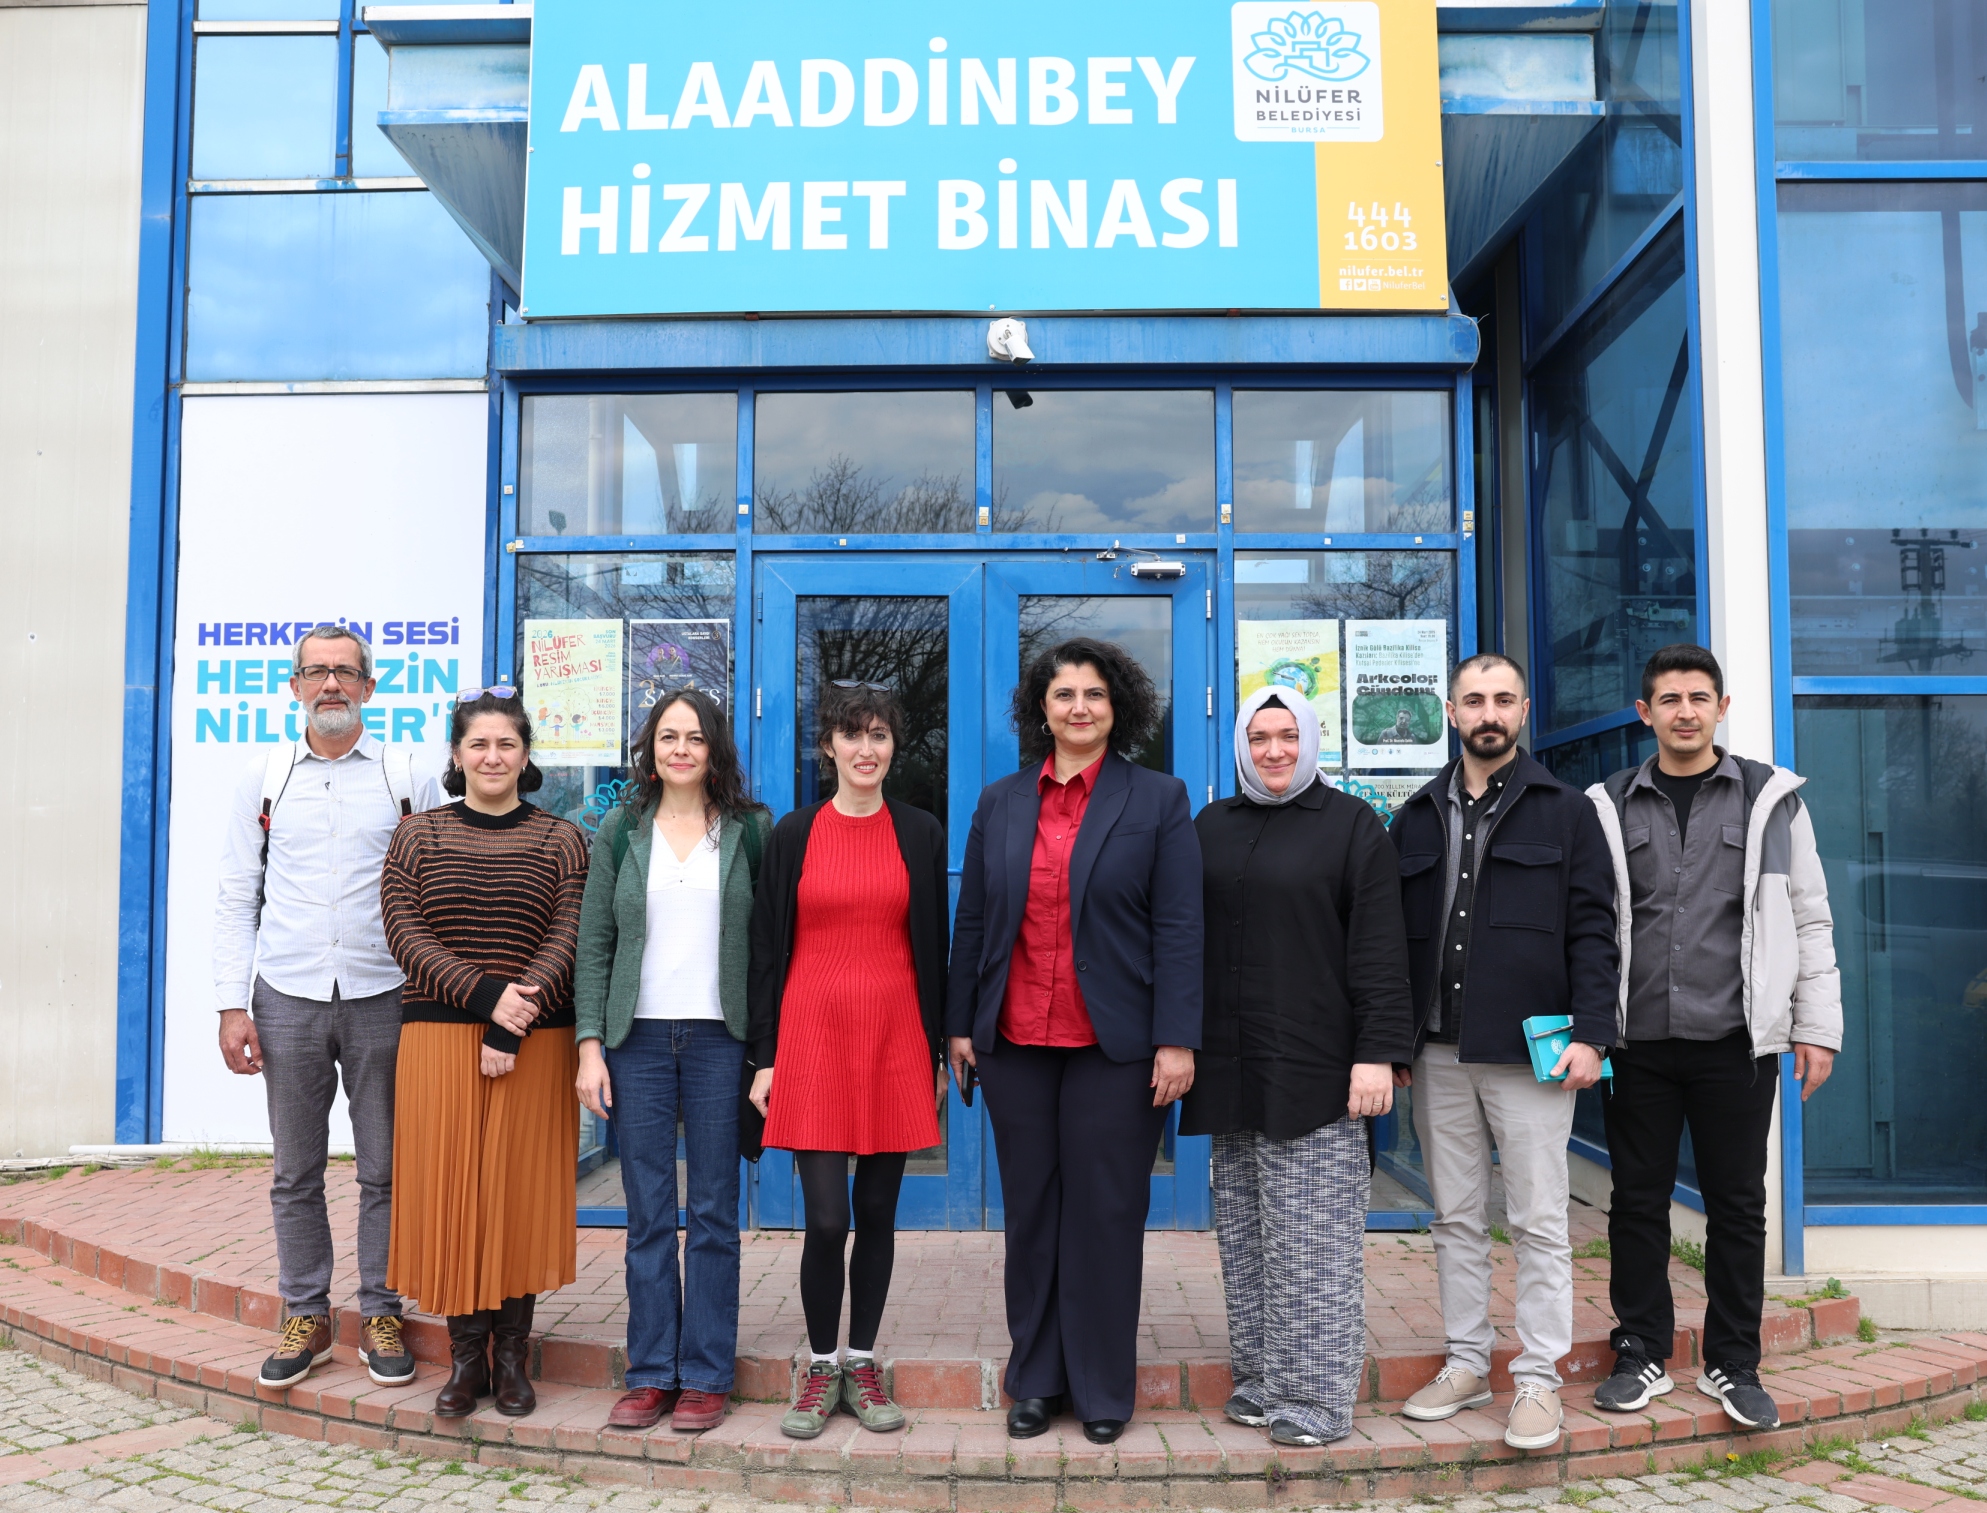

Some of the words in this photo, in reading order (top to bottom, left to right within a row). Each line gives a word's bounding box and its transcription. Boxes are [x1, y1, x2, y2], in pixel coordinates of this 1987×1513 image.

[560, 37, 1196, 132] ALAADDİNBEY
[1256, 86, 1362, 104] NİLÜFER
[1256, 108, 1361, 121] BELEDİYESİ
[562, 163, 906, 255] HİZMET
[938, 158, 1238, 249] BİNASI
[1348, 202, 1411, 228] 444
[1344, 226, 1417, 251] 1603
[1339, 265, 1424, 277] nilufer.bel.tr
[1383, 282, 1425, 290] NiluferBel
[382, 616, 459, 645] SESİ
[532, 630, 553, 638] 2026
[532, 634, 586, 653] NİLÜFER
[533, 650, 571, 667] RESİM
[197, 651, 459, 694] HEPZİN
[534, 659, 602, 680] YARIŞMASI
[1356, 674, 1438, 685] Arkeoloji
